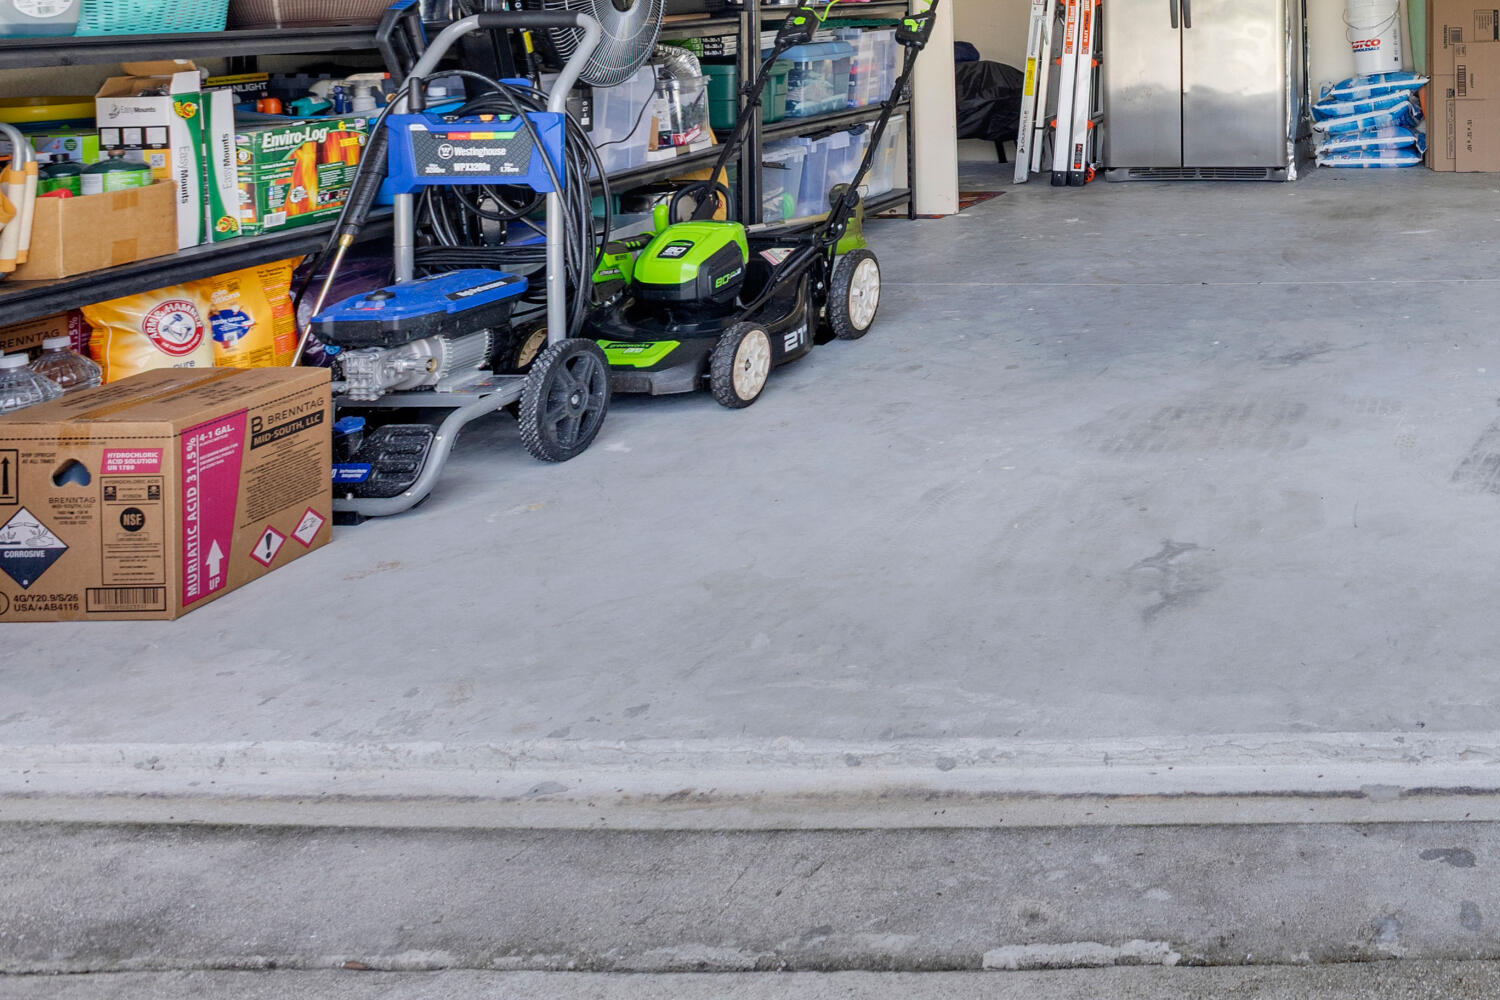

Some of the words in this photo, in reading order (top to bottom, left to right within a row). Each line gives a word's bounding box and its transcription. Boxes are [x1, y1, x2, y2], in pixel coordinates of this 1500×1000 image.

[338, 121, 345, 130] 6
[262, 127, 328, 148] Enviro-Log
[454, 146, 507, 157] Westinghouse
[715, 274, 729, 288] 80
[146, 318, 160, 339] ARM
[0, 329, 60, 349] RENNTAG
[267, 398, 324, 425] BRENNTAG
[306, 414, 320, 426] LLC
[200, 431, 213, 442] 4-1
[215, 424, 235, 436] GAL.
[186, 437, 197, 483] 31.5%
[186, 486, 197, 521] ACID
[122, 513, 142, 526] NSF
[4, 550, 45, 558] CORROSIVE
[187, 529, 198, 597] MURIATIC
[209, 578, 221, 590] UP
